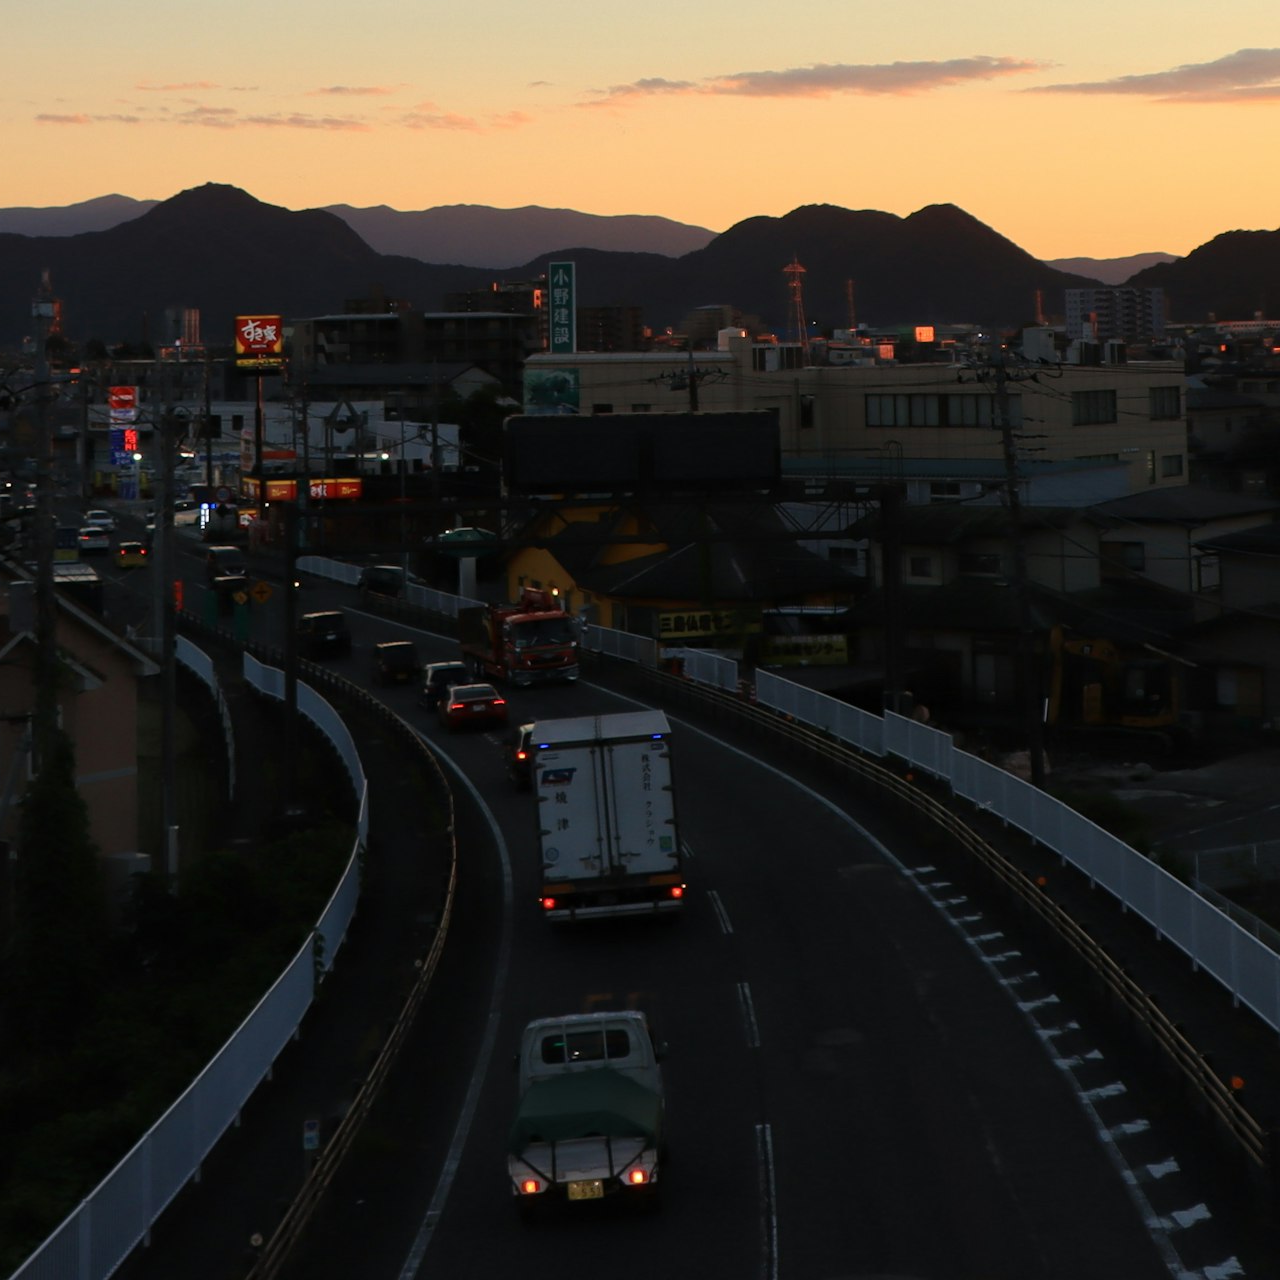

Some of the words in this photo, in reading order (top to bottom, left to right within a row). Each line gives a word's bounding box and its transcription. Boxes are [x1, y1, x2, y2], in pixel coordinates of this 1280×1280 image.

[553, 269, 569, 344] 小野建設
[241, 319, 277, 344] すき家
[641, 753, 652, 792] 株式会社
